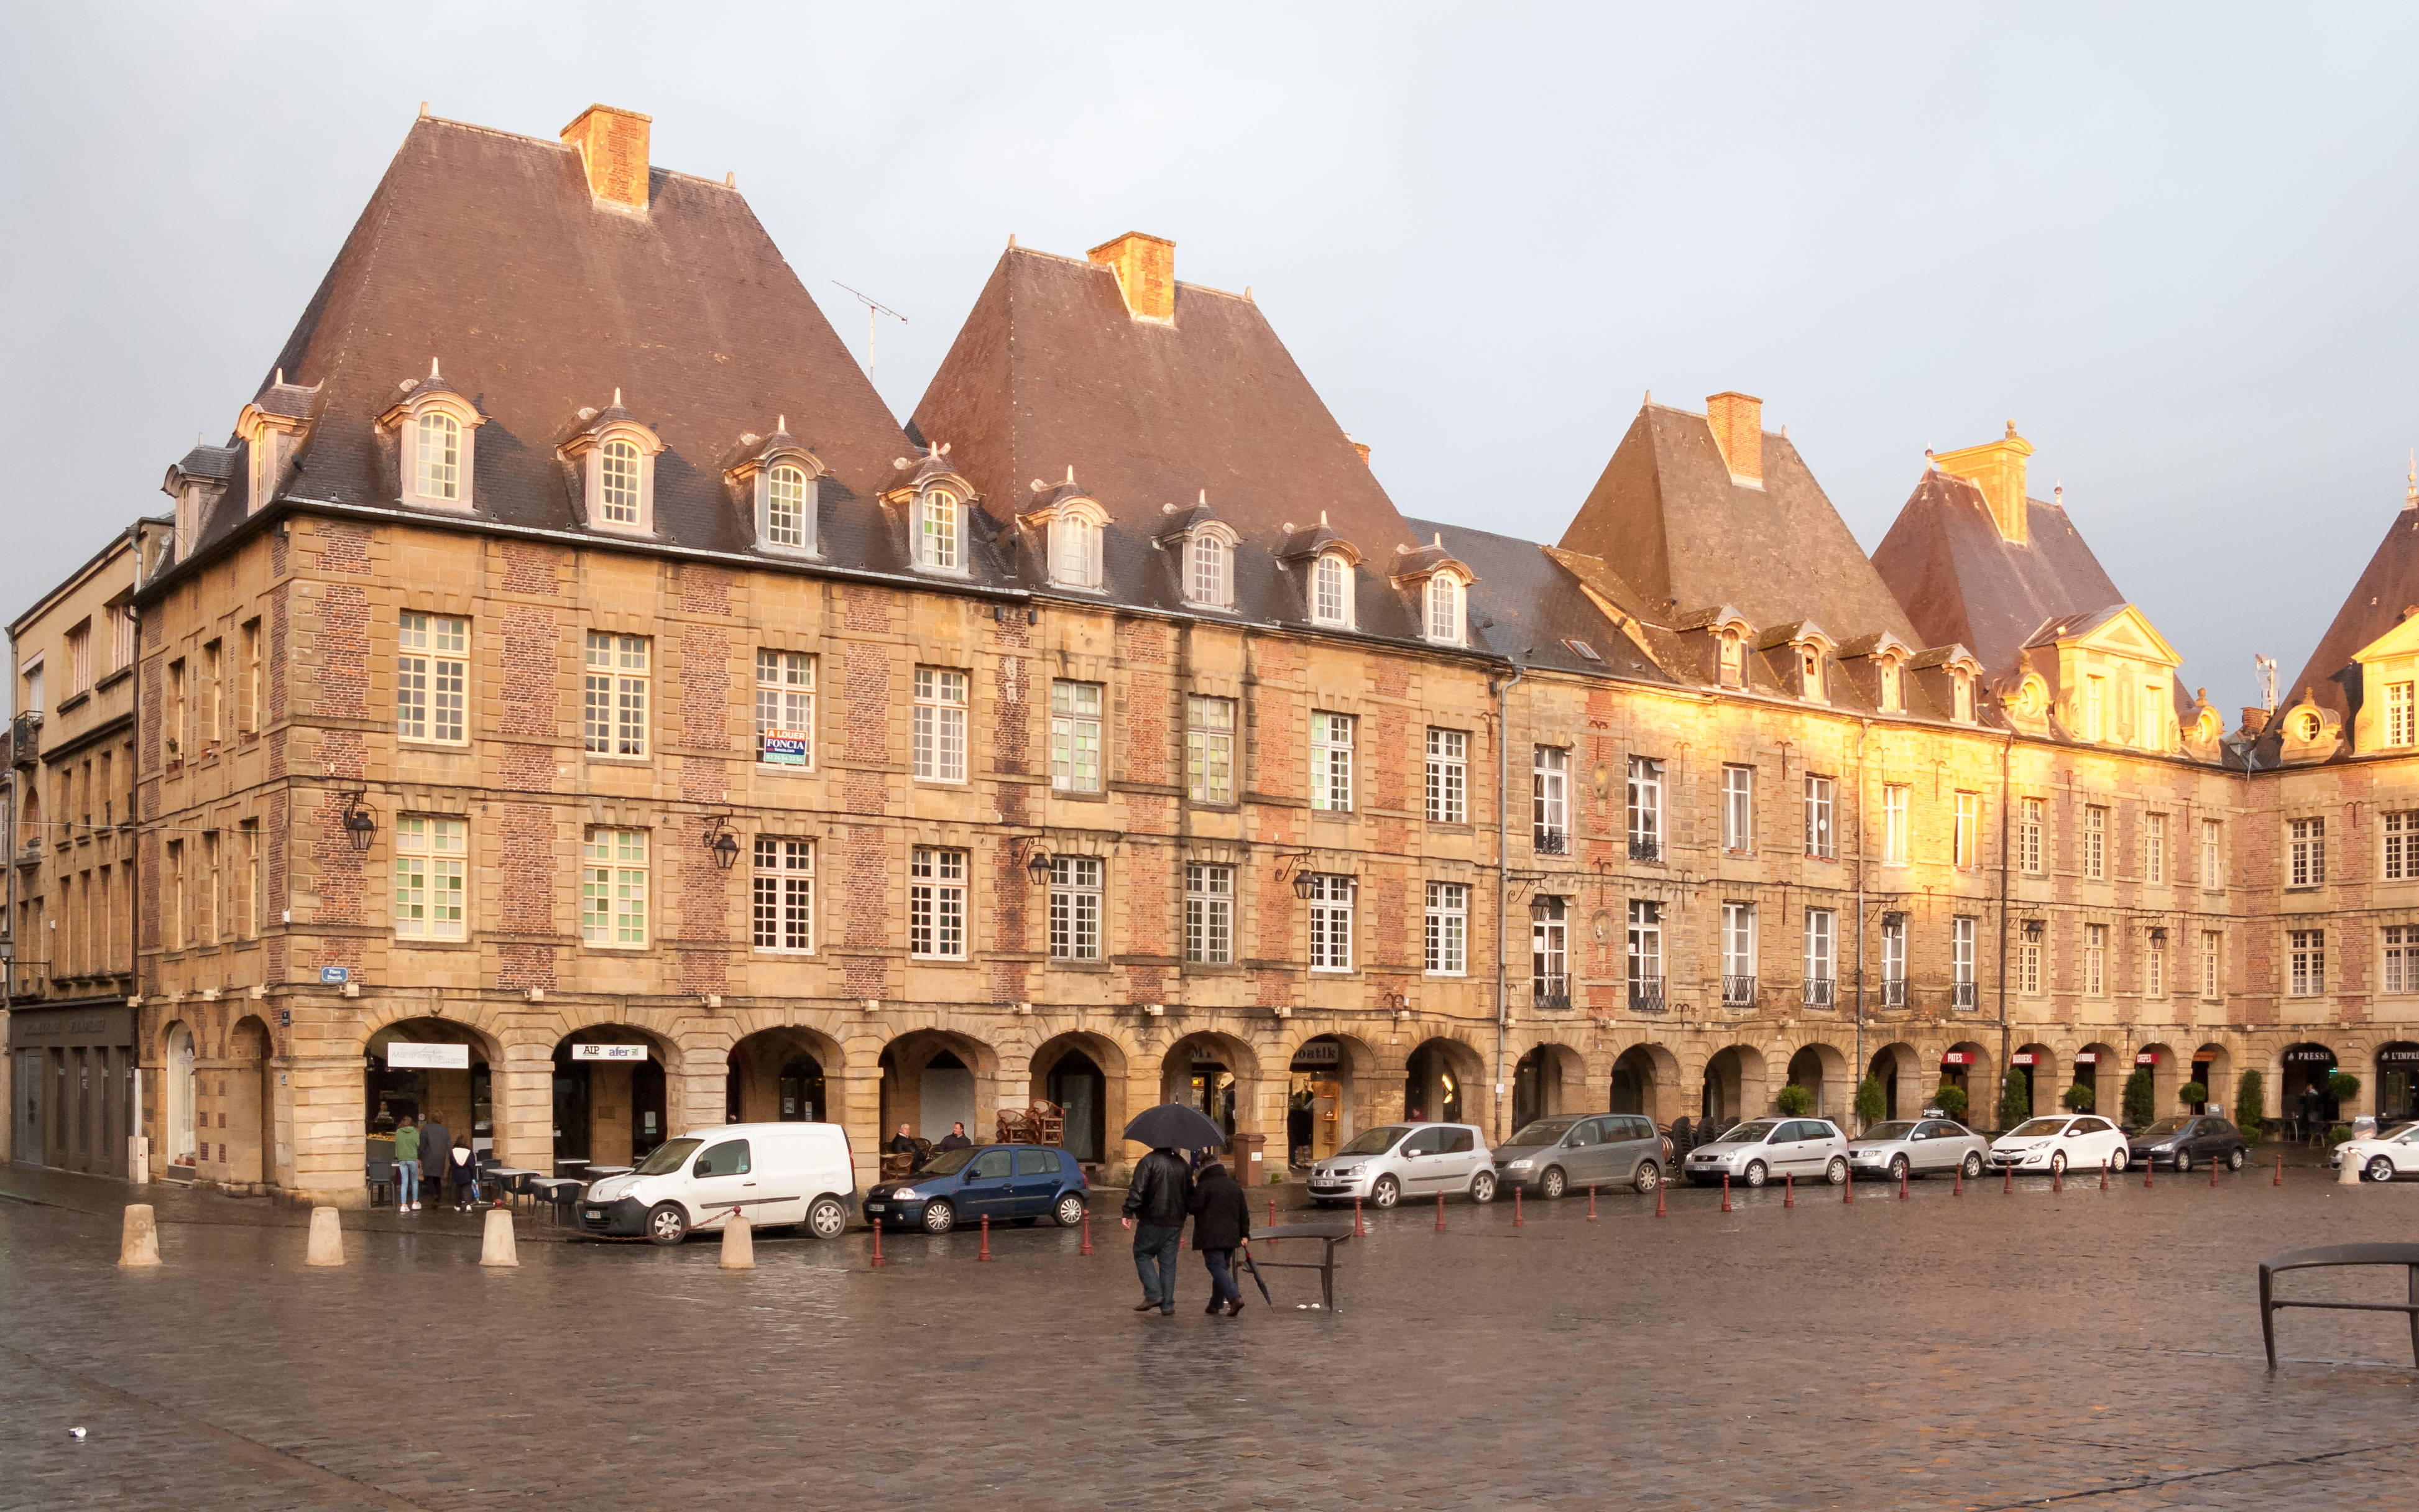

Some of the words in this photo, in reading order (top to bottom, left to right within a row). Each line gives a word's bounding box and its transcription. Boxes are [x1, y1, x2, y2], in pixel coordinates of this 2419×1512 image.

[777, 731, 805, 740] LOUER
[767, 739, 804, 750] FONCIA
[609, 1046, 630, 1057] afer
[2298, 1052, 2329, 1060] PRESSE
